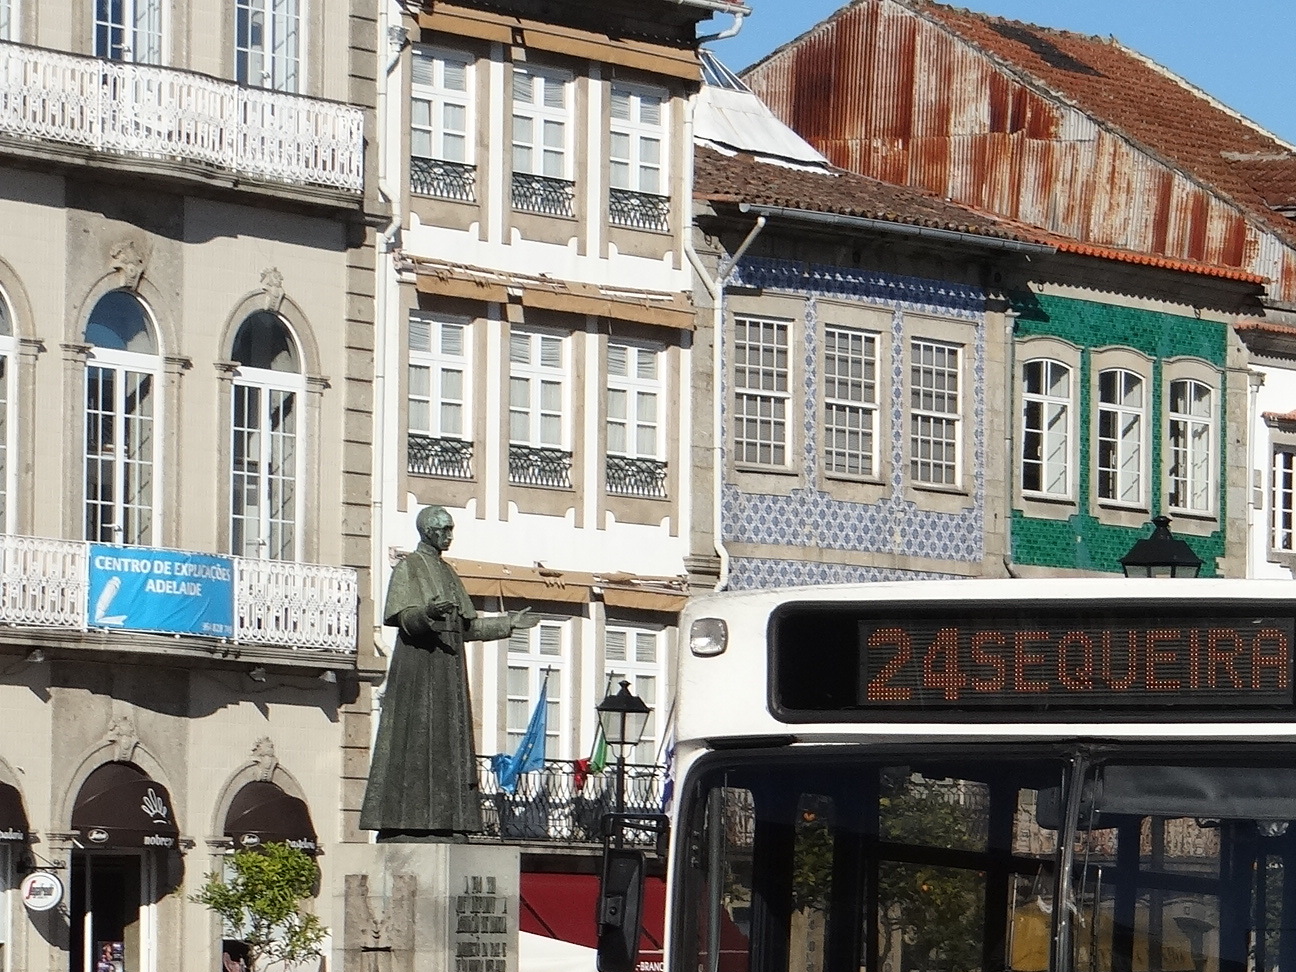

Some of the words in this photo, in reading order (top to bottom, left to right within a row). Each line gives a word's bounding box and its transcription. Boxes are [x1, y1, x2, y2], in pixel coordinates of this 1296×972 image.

[95, 556, 151, 574] CENTRO
[153, 560, 172, 575] DE
[174, 562, 231, 582] EXPLICAÇÕES
[145, 579, 202, 597] ADELAIDE
[867, 628, 966, 700] 24
[971, 629, 1288, 691] SEQUEIRA
